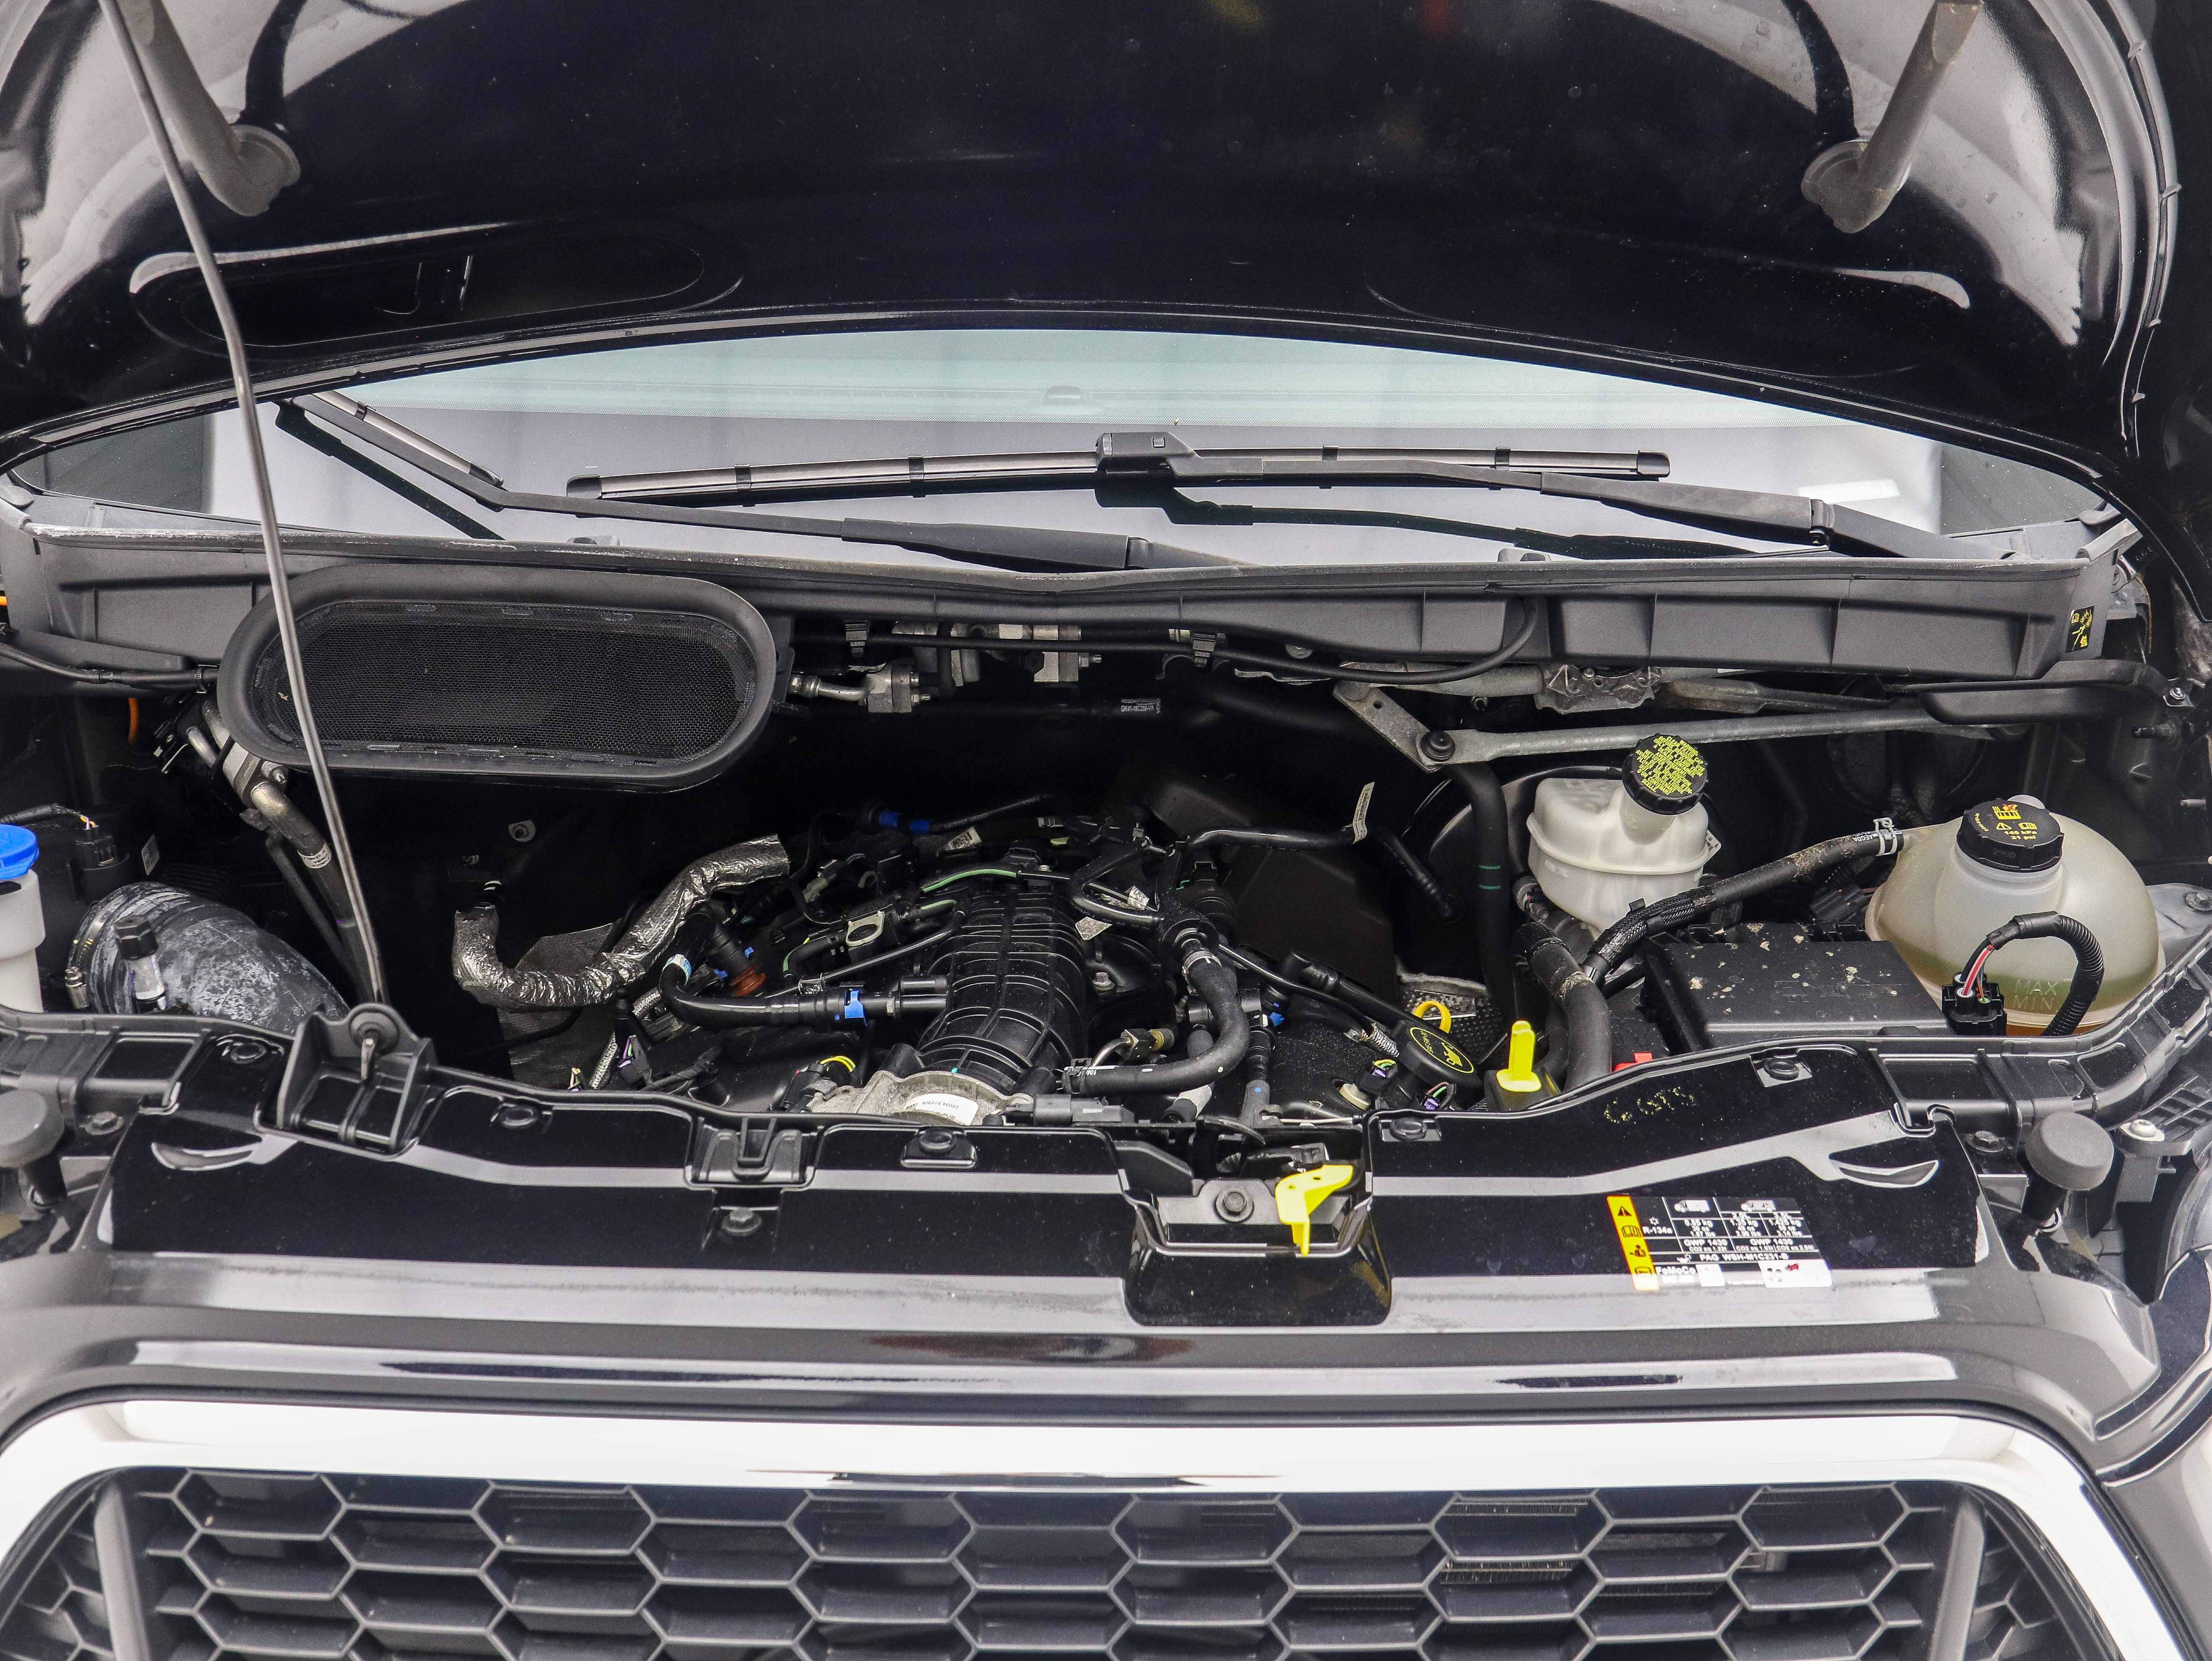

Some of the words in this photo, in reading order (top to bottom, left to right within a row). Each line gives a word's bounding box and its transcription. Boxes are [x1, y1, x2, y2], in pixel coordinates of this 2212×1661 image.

[2014, 980, 2058, 995] MAX
[2013, 995, 2054, 1010] MIN
[1699, 1253, 1720, 1262] PAG
[1655, 1266, 1697, 1275] FoMoCo
